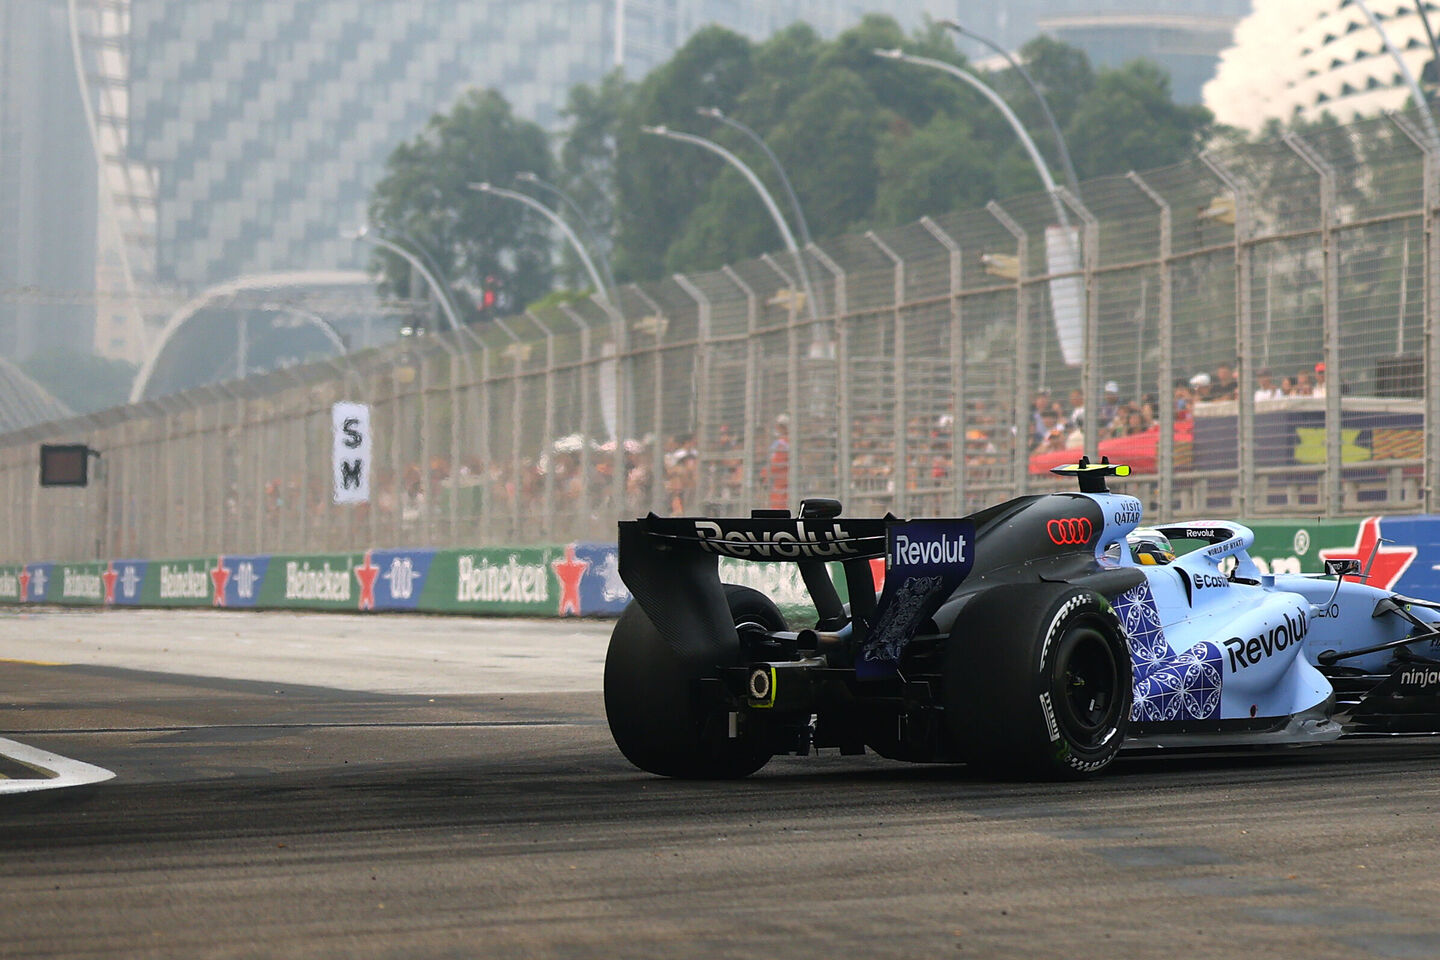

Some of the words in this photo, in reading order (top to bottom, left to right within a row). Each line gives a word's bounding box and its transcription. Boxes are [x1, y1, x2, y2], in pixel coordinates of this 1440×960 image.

[1114, 511, 1140, 526] QATAR
[1186, 529, 1215, 538] Revolut
[694, 521, 858, 557] Revolut
[896, 534, 966, 565] Revolut
[1207, 546, 1222, 556] WORLD
[1223, 543, 1230, 552] OF
[457, 555, 549, 602] Heineken
[1223, 606, 1309, 673] Revolut
